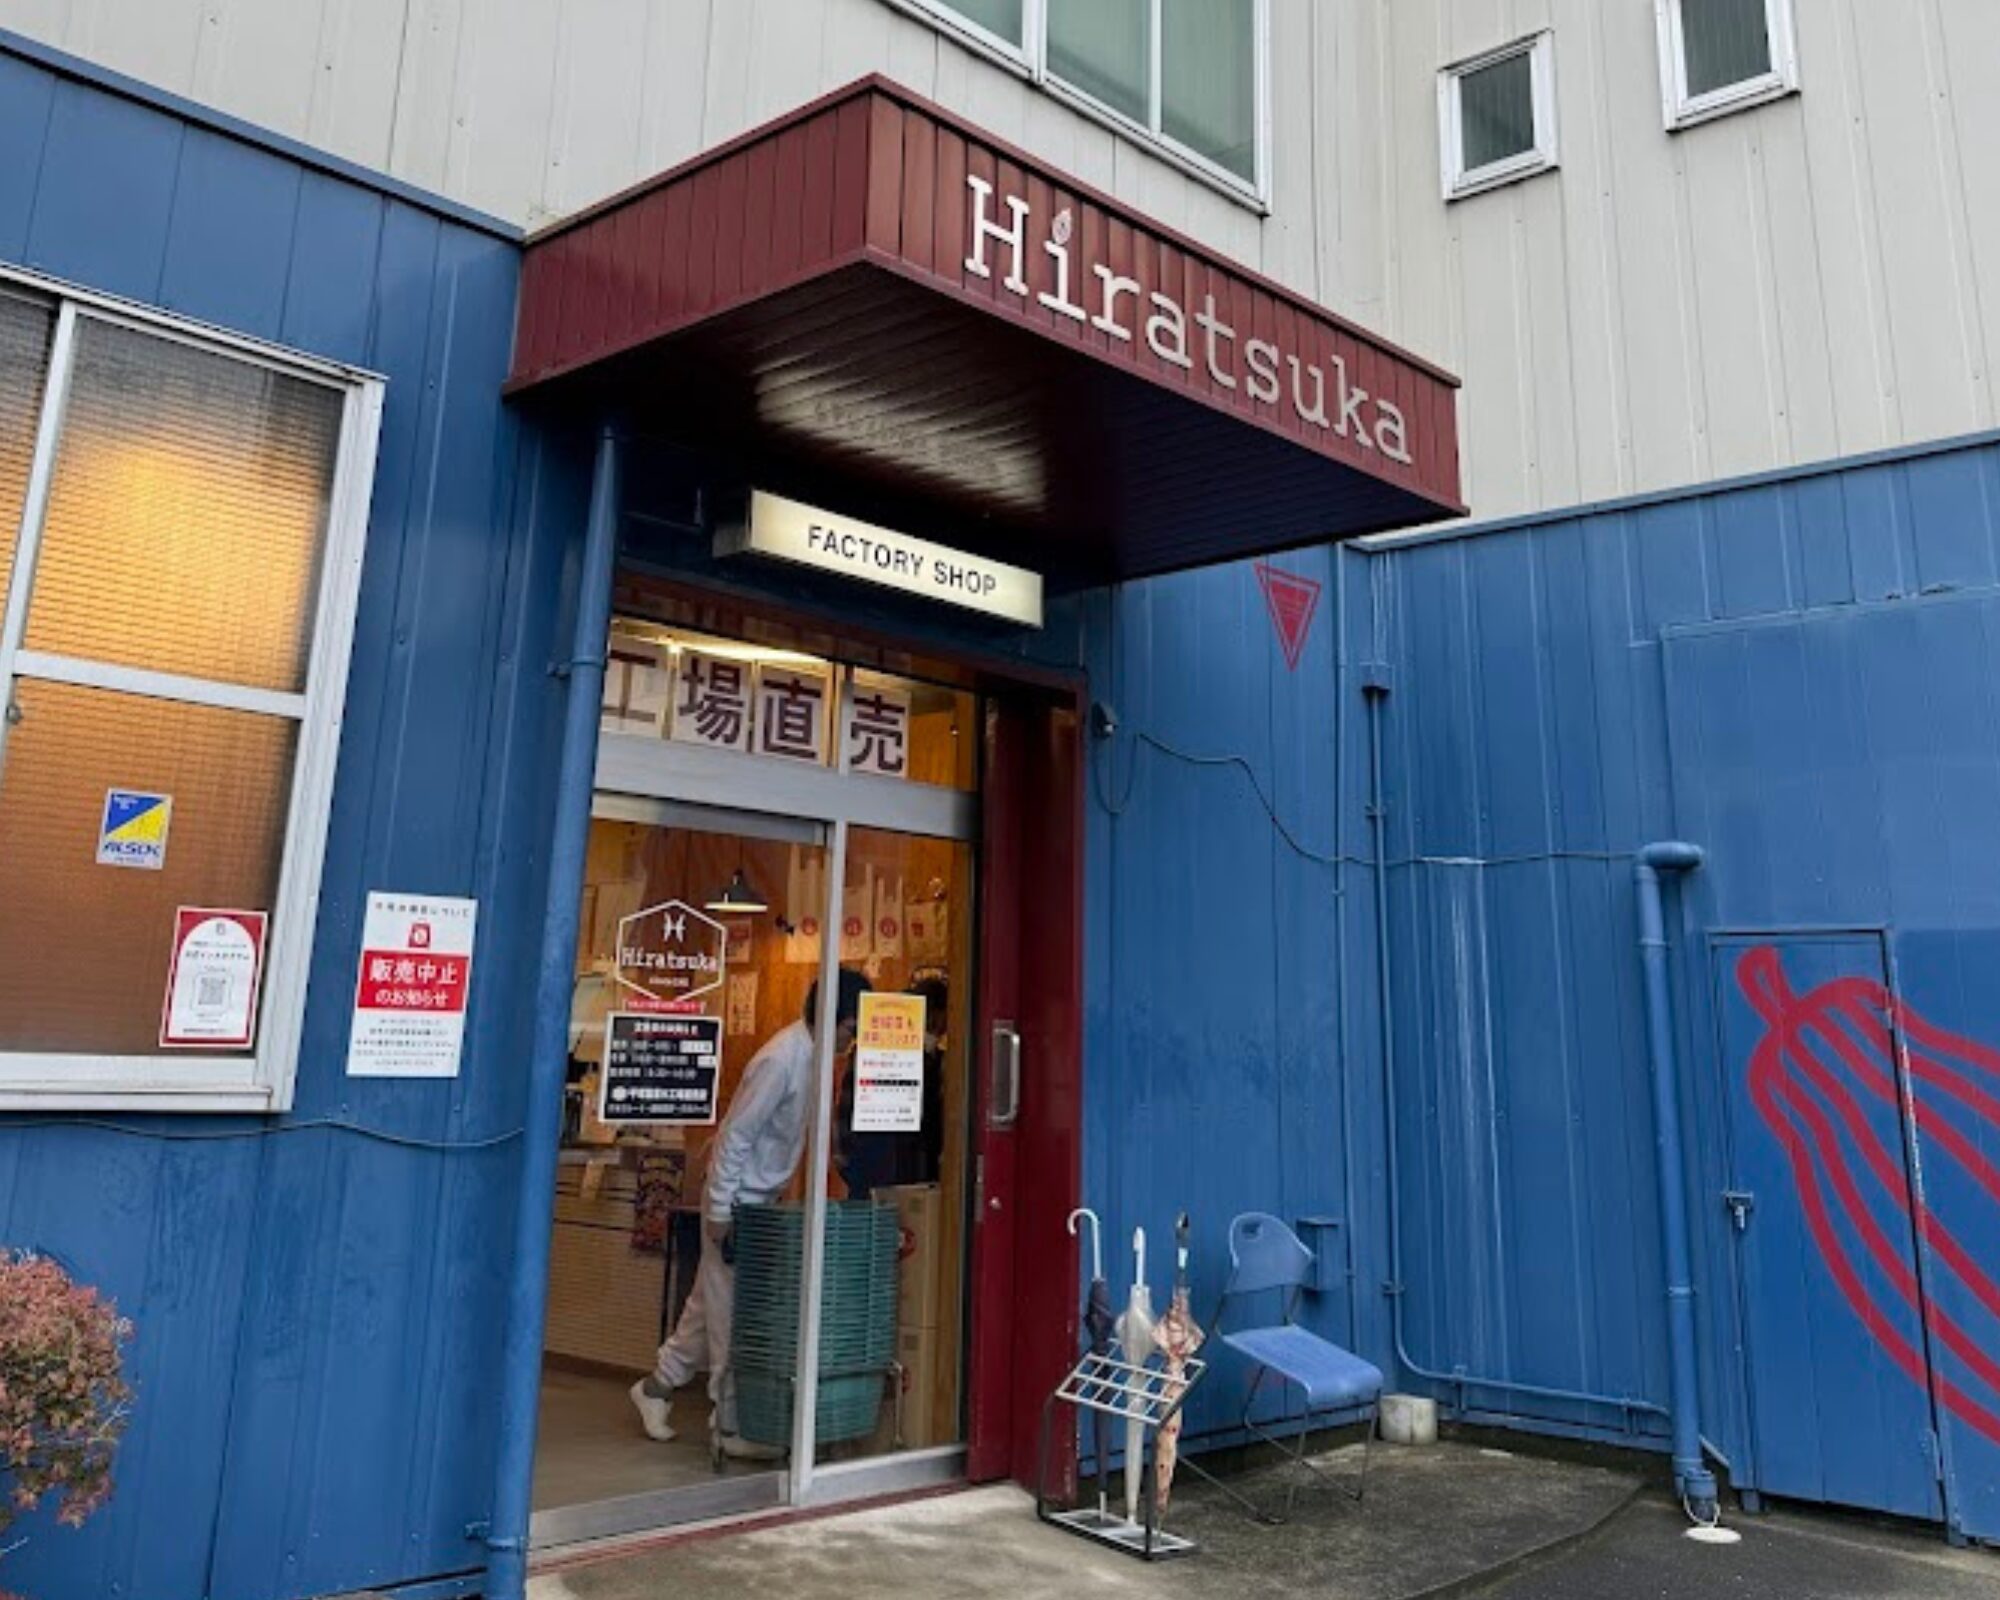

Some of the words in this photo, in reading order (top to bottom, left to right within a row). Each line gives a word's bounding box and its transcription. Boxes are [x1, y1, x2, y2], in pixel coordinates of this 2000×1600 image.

[964, 173, 1412, 465] Hiratsuka
[807, 524, 924, 577] FACTORY
[934, 560, 997, 597] SHOP
[602, 649, 906, 773] 工場直売
[369, 957, 460, 986] 販売中止
[621, 946, 718, 972] Hiratsuka
[374, 988, 449, 1009] のお知らせ
